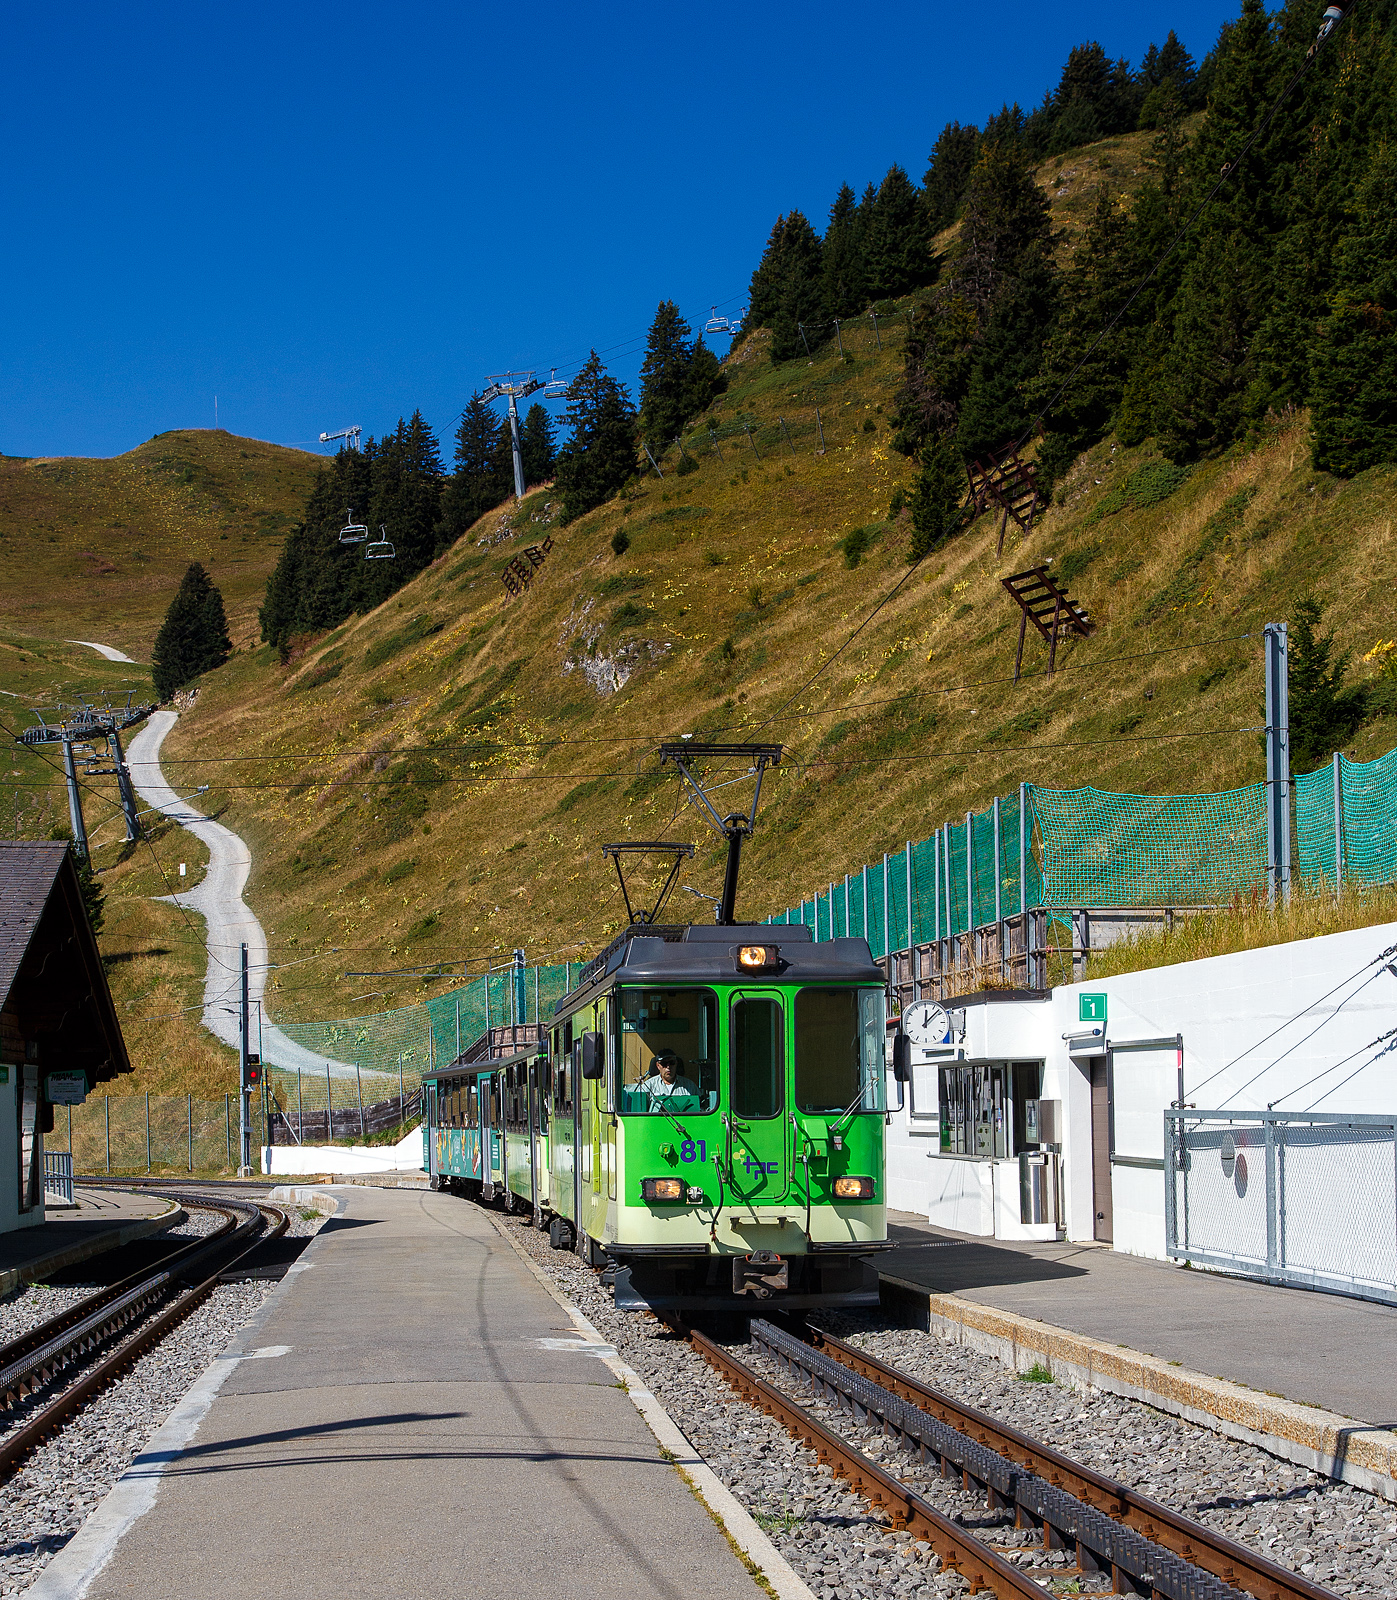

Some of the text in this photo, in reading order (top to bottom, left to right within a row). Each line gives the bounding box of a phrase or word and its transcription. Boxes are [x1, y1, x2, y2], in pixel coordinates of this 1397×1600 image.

[1089, 1002, 1096, 1017] 1
[680, 1140, 706, 1163] 81
[743, 1155, 779, 1180] tpc
